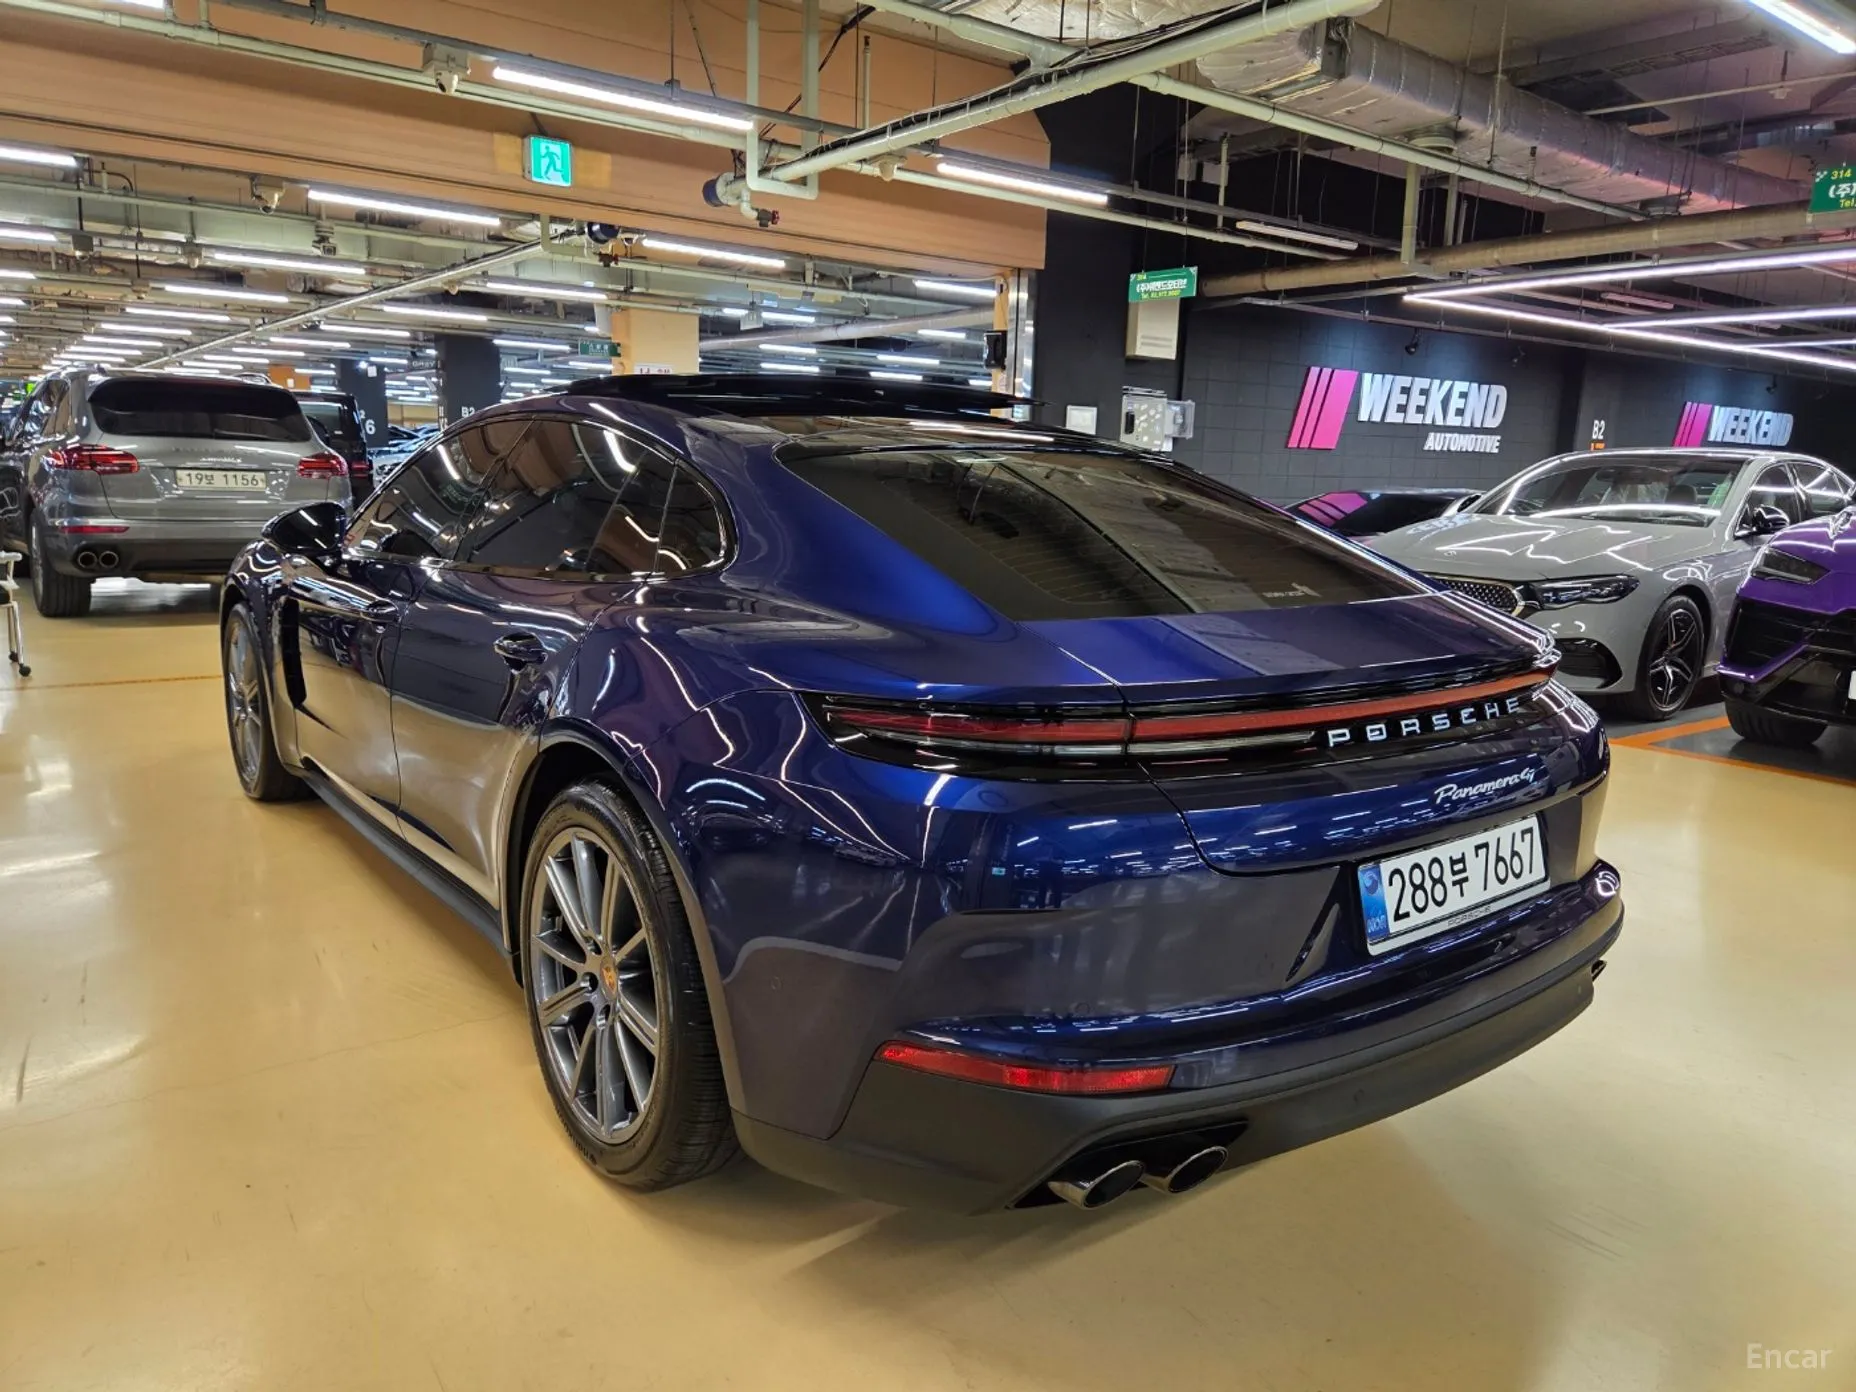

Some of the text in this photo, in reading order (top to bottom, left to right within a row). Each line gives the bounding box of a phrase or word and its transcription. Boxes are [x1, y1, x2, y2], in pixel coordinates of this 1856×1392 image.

[1831, 169, 1851, 180] 314
[1358, 372, 1508, 428] WEEKEND
[365, 419, 376, 435] 6
[1592, 419, 1606, 440] B2
[1708, 405, 1794, 447] WEEKEND
[1423, 432, 1501, 453] AUTOMOTIVE
[186, 472, 259, 486] 19보 1156
[1327, 698, 1520, 747] PORSCHE
[1388, 826, 1534, 922] 288부 7667
